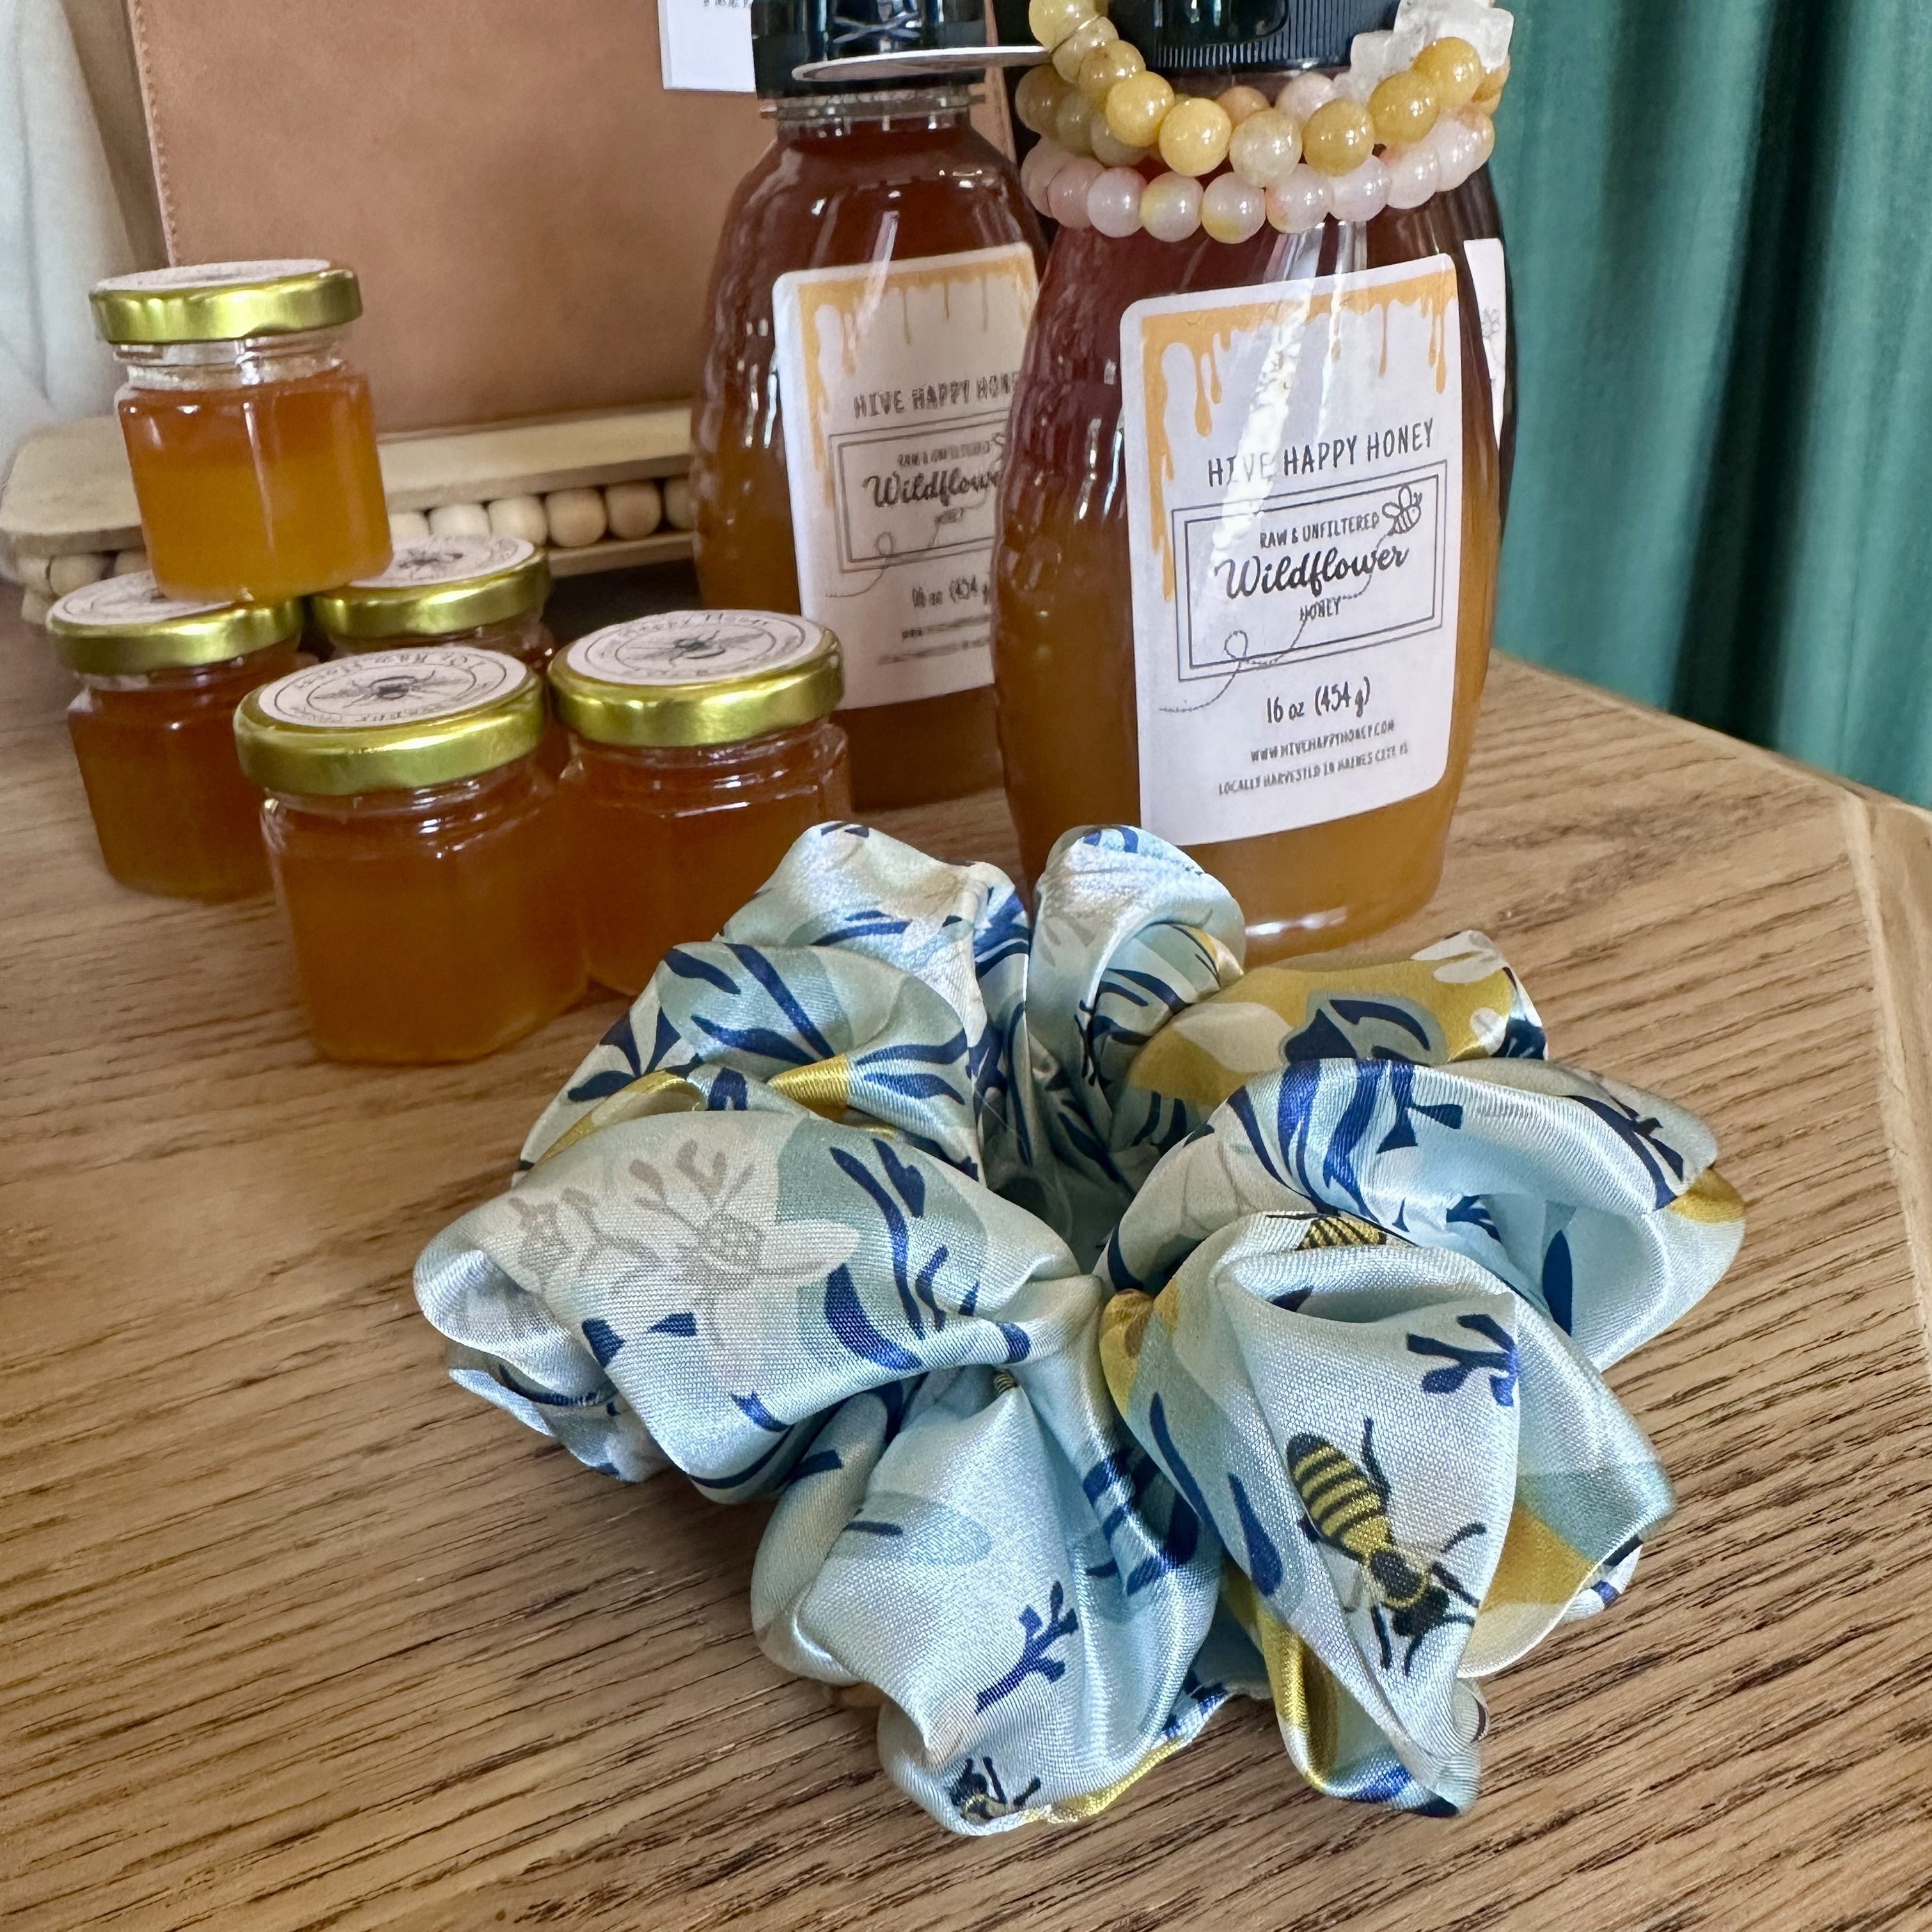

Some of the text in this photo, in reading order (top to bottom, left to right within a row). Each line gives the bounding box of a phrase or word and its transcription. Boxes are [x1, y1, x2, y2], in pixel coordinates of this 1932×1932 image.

[853, 389, 906, 419] HIVE
[911, 379, 970, 410] HAPPY
[1207, 417, 1433, 487] HIVE HAPPY HONEY
[1260, 511, 1380, 549] RAW & UNFILTERED
[1213, 546, 1410, 599] Wildflower
[1299, 595, 1342, 622] HONEY
[1267, 696, 1284, 724] 16
[1289, 702, 1305, 721] oz
